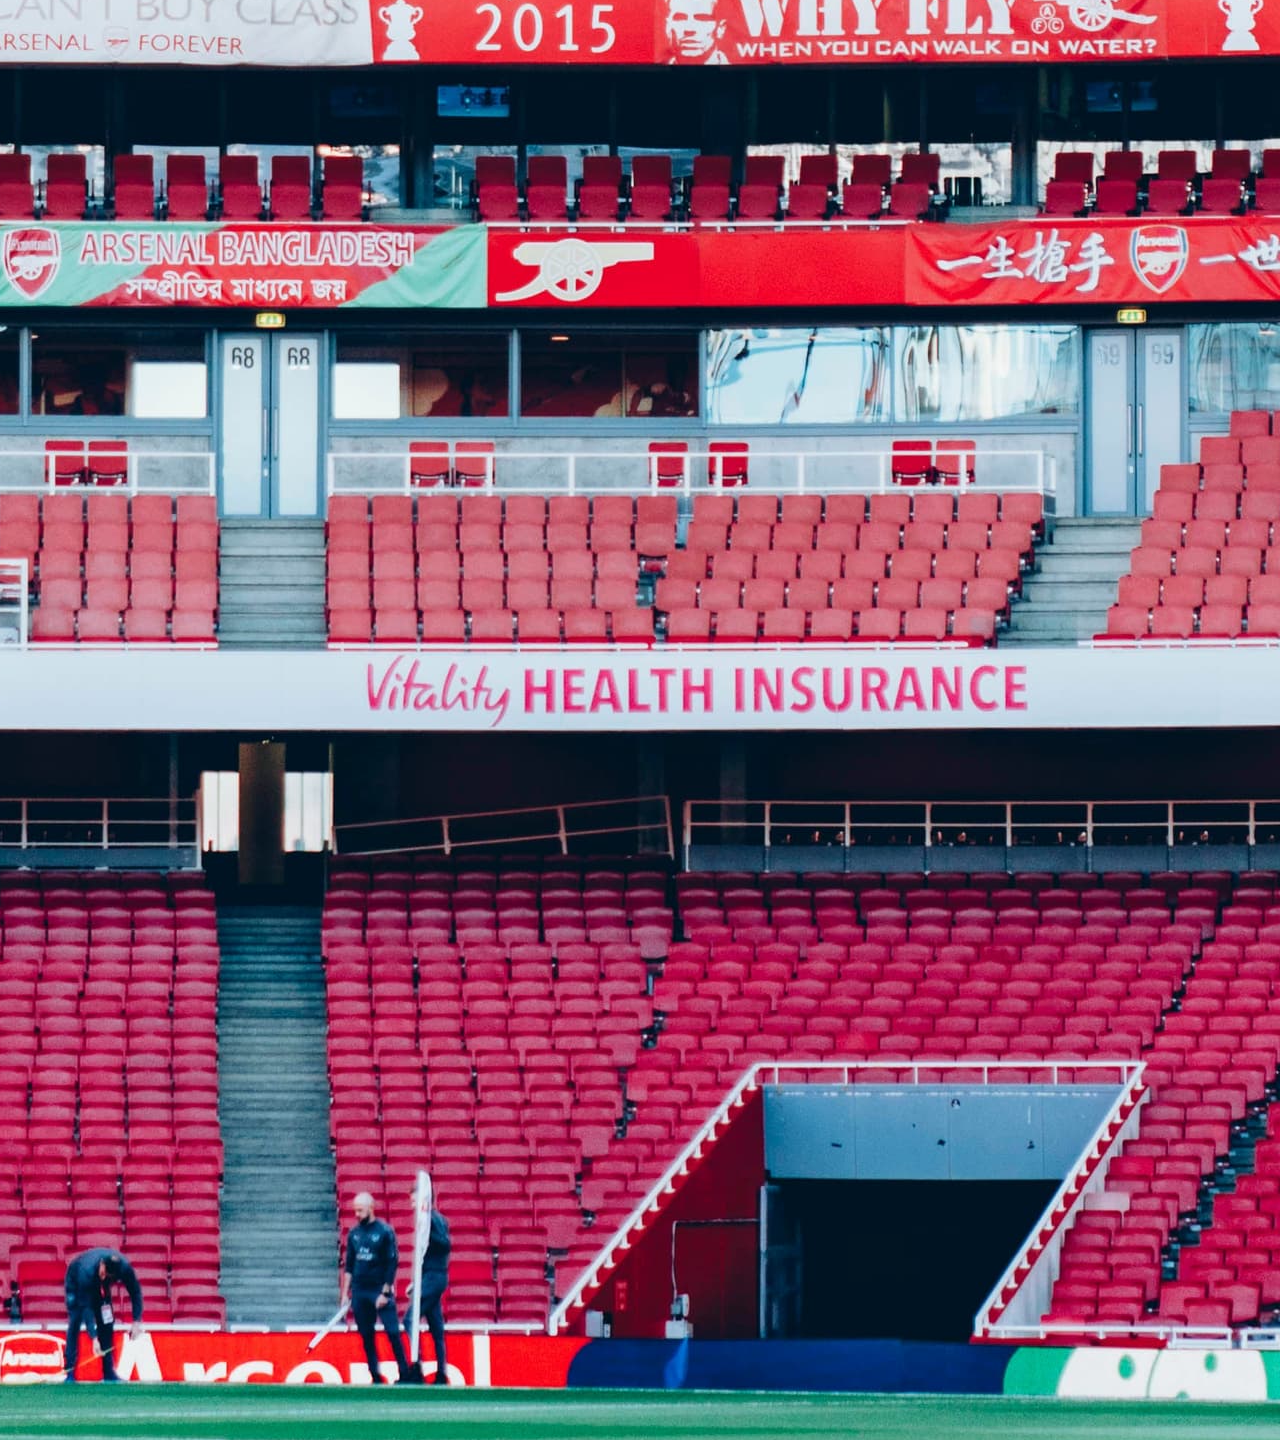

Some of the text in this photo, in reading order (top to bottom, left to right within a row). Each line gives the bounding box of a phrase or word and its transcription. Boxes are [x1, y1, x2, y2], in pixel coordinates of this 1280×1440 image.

[474, 2, 617, 55] 2015
[138, 33, 244, 55] FOREVER
[736, 38, 1158, 58] WHEN YOU CAN WALK ON WATER?
[78, 231, 415, 267] ARSENAL BANGLADESH
[232, 347, 254, 368] 68
[287, 347, 310, 365] 68
[365, 654, 1028, 727] Vitality HEALTH INSURANCE
